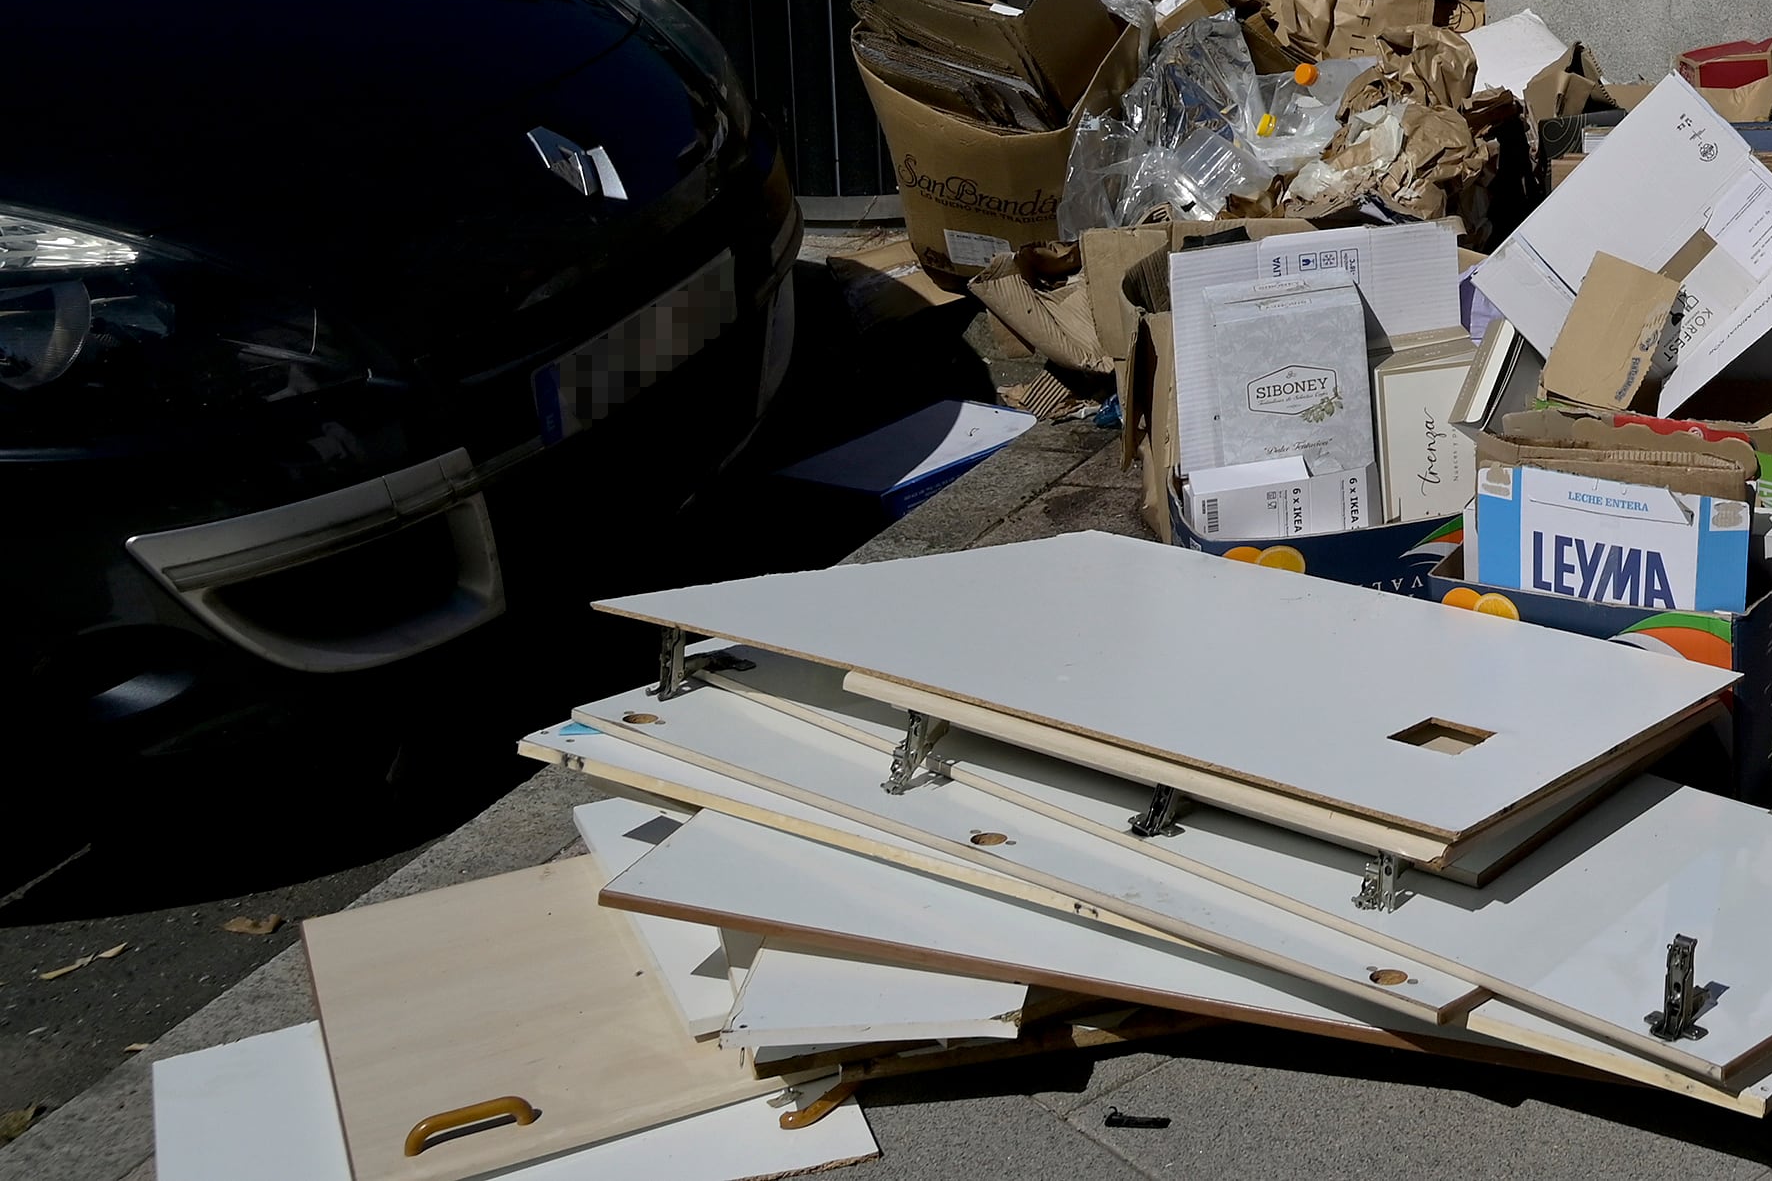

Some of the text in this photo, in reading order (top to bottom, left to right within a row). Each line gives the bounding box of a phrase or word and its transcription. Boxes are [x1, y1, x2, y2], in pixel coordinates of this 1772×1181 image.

[1663, 307, 1713, 362] KÖRFEST
[1256, 377, 1328, 400] SIBONEY
[1417, 407, 1447, 497] trenza
[1292, 487, 1302, 495] 6
[1349, 477, 1358, 485] 6
[1350, 496, 1360, 523] IKEA
[1568, 491, 1649, 513] LECHE ENTERA
[1293, 507, 1303, 533] IKEA
[1532, 530, 1678, 610] LEYMA
